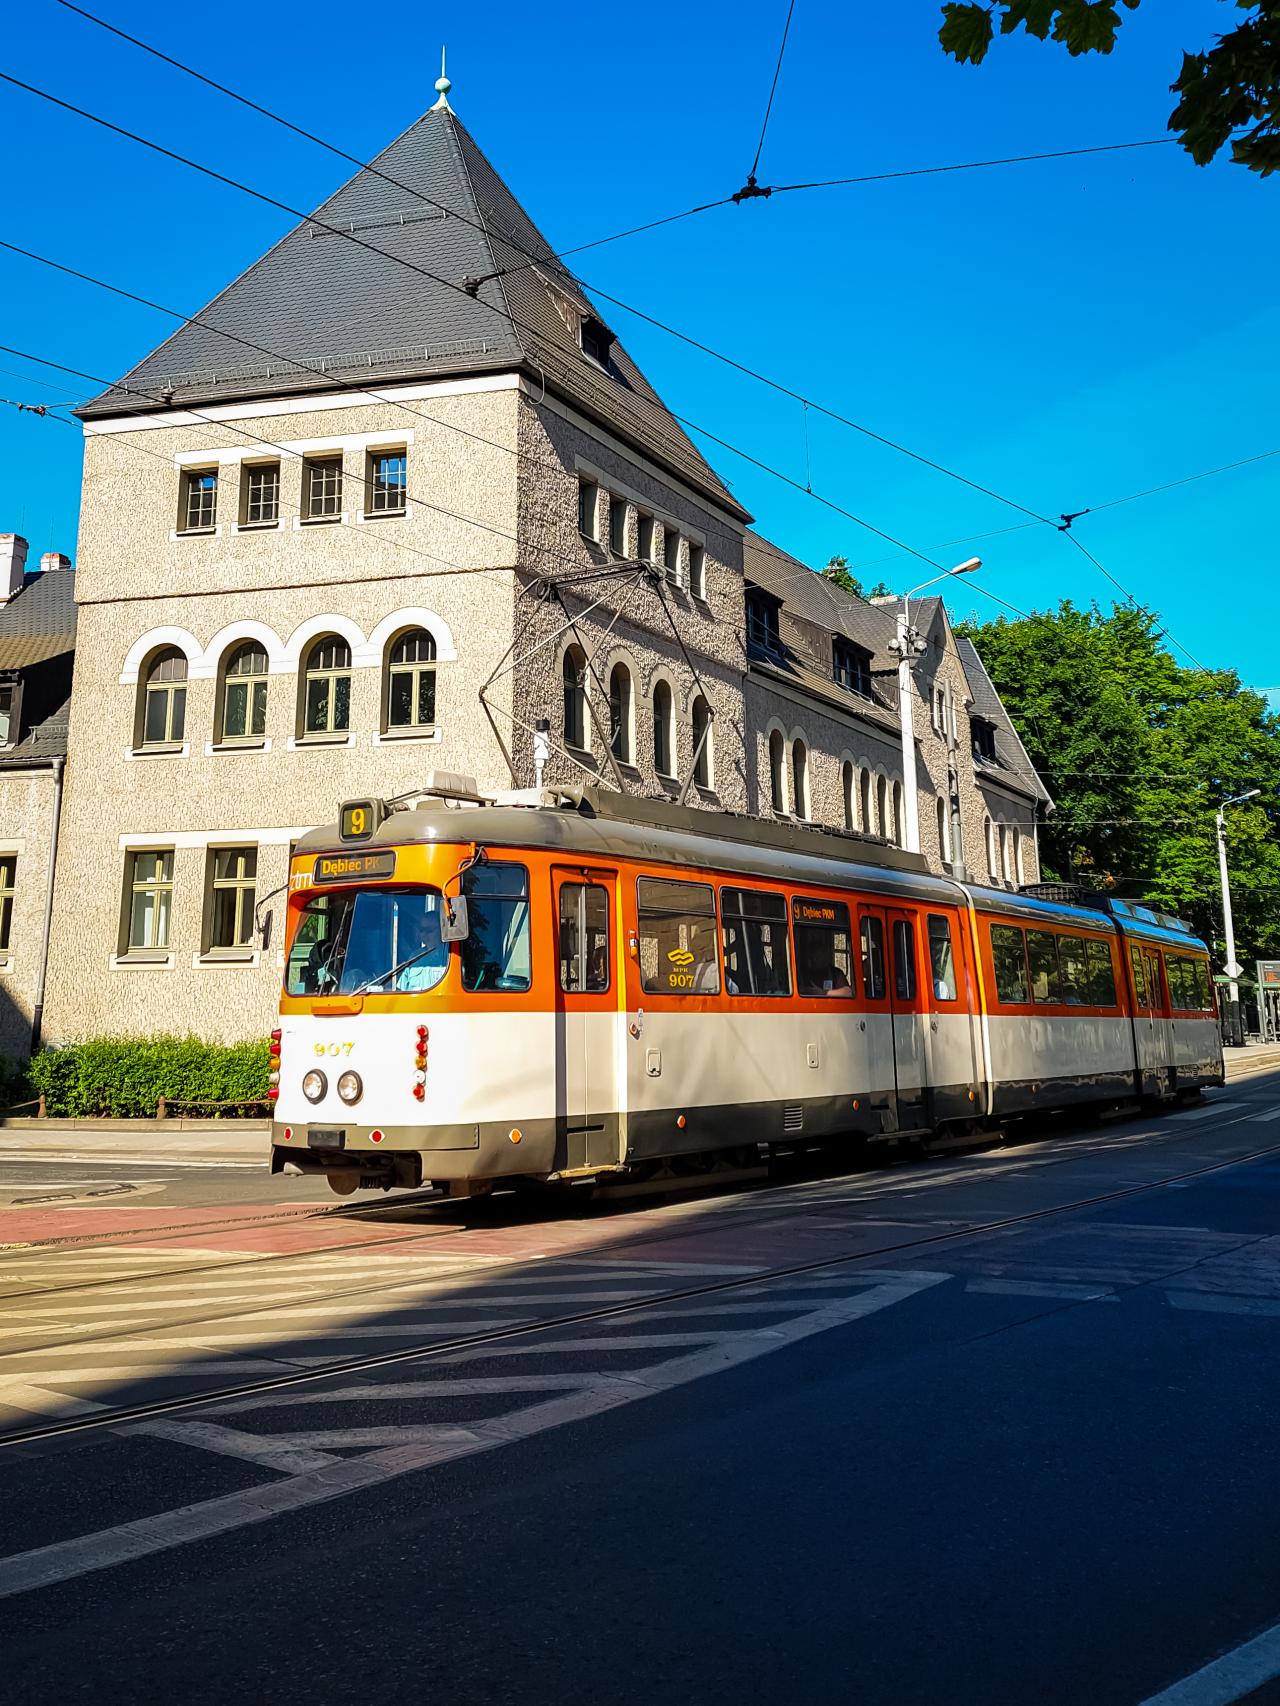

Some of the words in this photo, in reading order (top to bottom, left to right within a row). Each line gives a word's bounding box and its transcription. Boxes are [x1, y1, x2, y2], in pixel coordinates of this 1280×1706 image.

[352, 809, 364, 834] 9
[794, 904, 800, 919] 9
[669, 974, 694, 988] 907
[314, 1041, 355, 1057] 907
